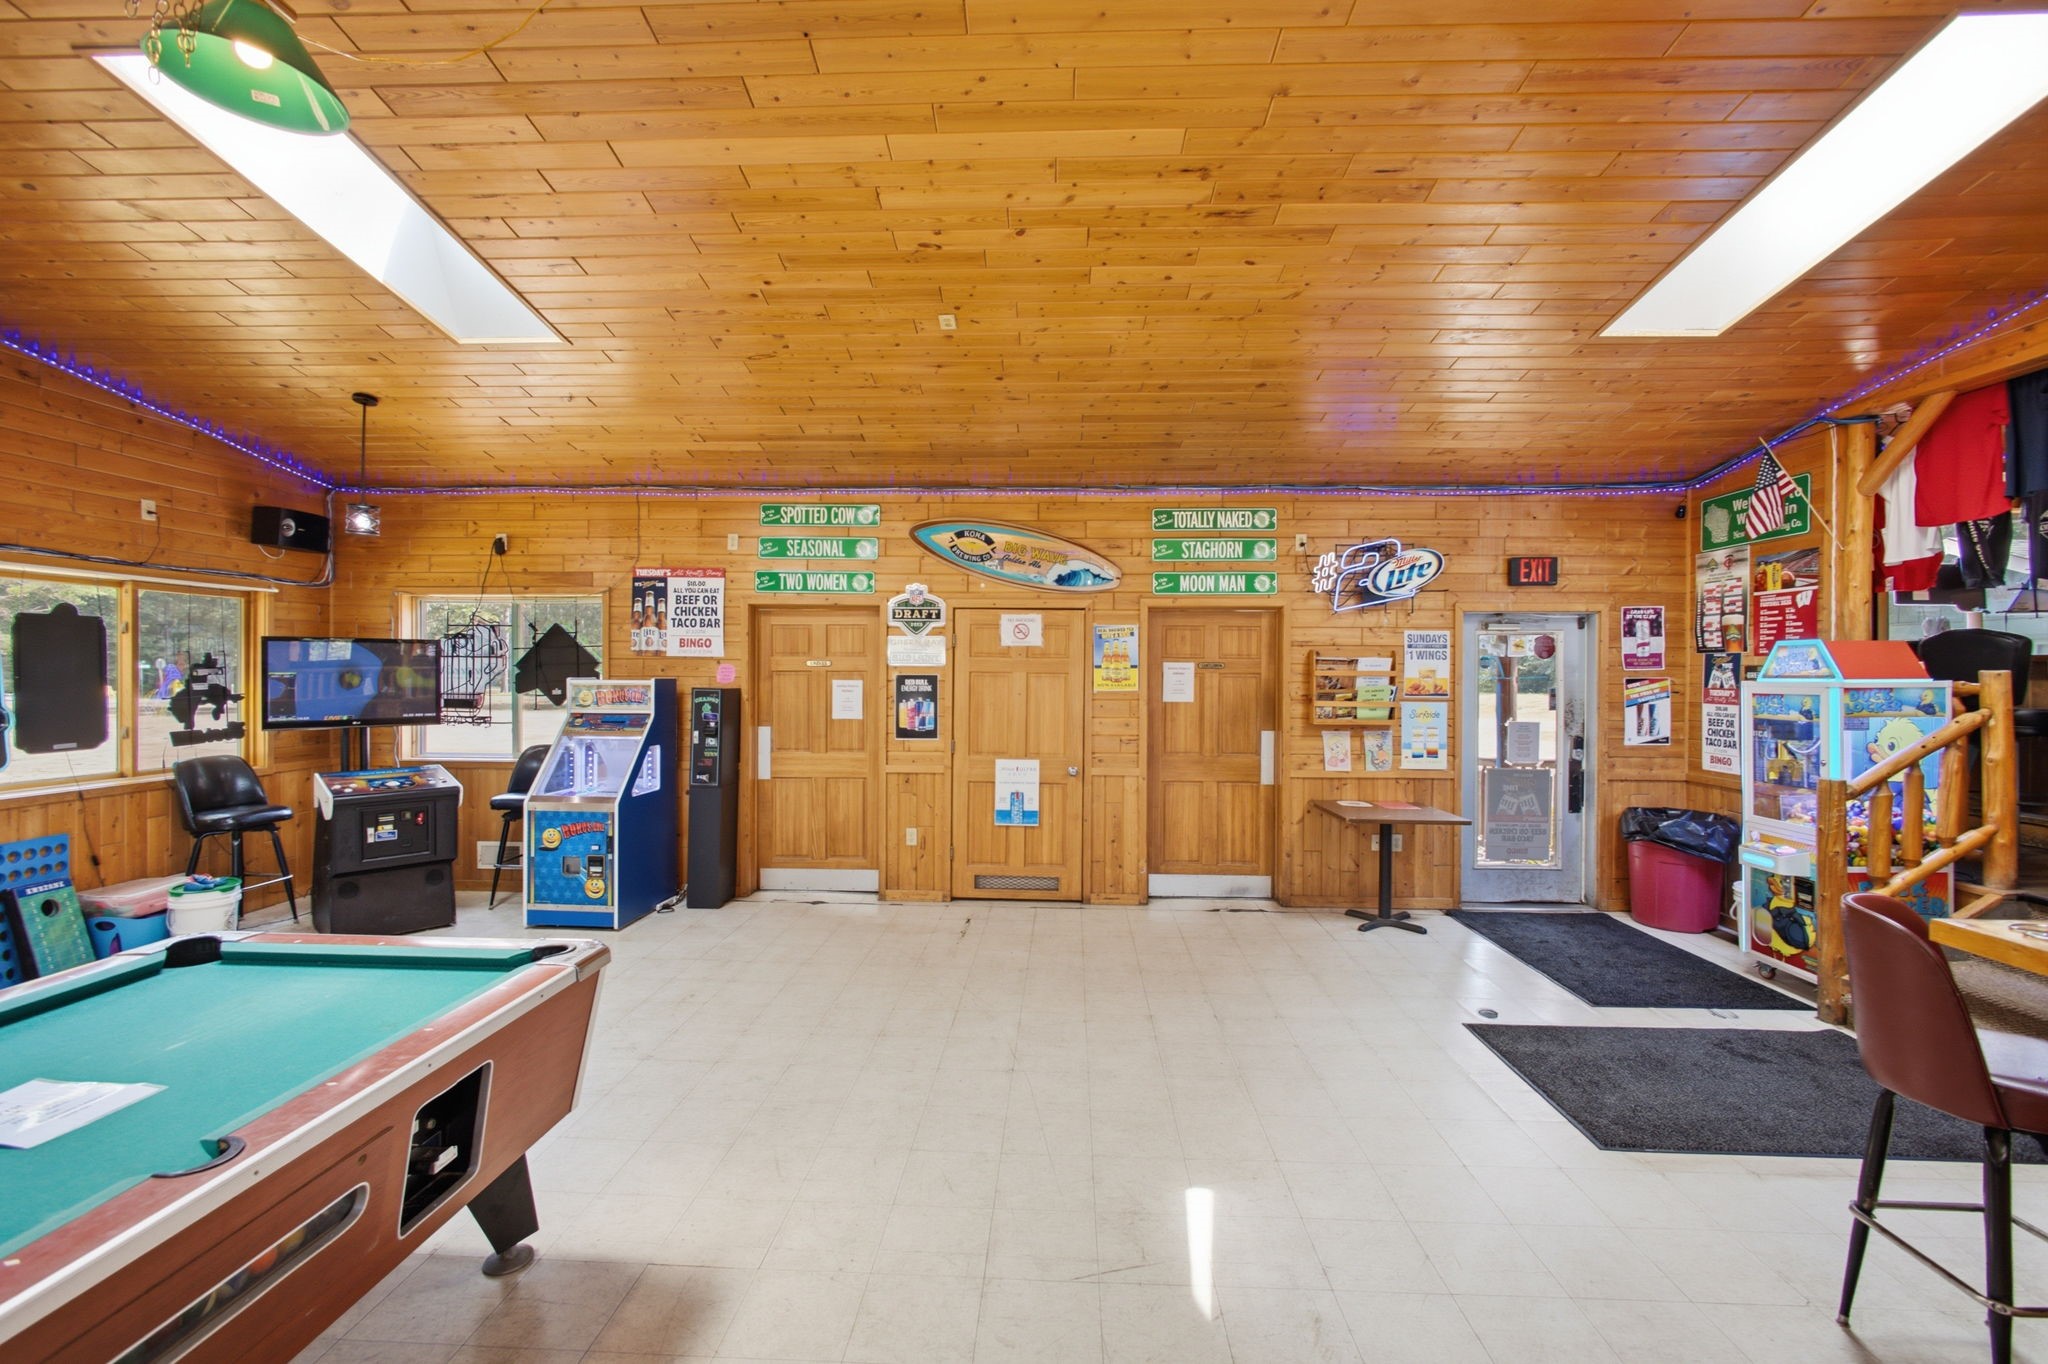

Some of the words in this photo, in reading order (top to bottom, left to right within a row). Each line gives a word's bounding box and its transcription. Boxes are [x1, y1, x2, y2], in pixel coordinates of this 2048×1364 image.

[780, 507, 827, 523] SPOTTED
[831, 507, 856, 523] COW
[1172, 511, 1215, 528] TOTALLY
[1217, 511, 1252, 528] NAKED
[963, 529, 986, 541] KONA
[786, 540, 845, 556] SEASONAL
[952, 546, 981, 562] BREWING
[1003, 541, 1026, 557] BIG
[1031, 546, 1068, 565] WAVE
[1181, 541, 1243, 558] STAGHORN
[1002, 554, 1027, 567] Golden
[1029, 560, 1042, 569] Ale
[1392, 555, 1424, 568] Miller
[1520, 558, 1553, 582] EXIT
[779, 573, 803, 590] TWO
[807, 574, 847, 591] WOMEN
[1384, 561, 1432, 592] Lite
[1180, 575, 1214, 592] MOON
[1219, 575, 1246, 592] MAN
[675, 595, 700, 605] BEEF
[702, 595, 717, 605] OR
[674, 607, 718, 617] CHICKEN
[895, 610, 938, 618] DRAFT
[671, 618, 697, 628] TACO
[699, 618, 720, 628] BAR
[679, 638, 712, 648] BINGO
[1407, 633, 1448, 644] SUNDAYS
[1416, 650, 1448, 660] WINGS
[1849, 689, 1894, 701] DUCK
[1845, 701, 1902, 712] LOCKER
[1708, 718, 1724, 727] BEEF
[1725, 720, 1735, 729] OR
[1707, 728, 1735, 738] CHICKEN
[1705, 738, 1721, 747] TACO
[1723, 740, 1737, 749] BAR
[1709, 755, 1732, 766] BINGO
